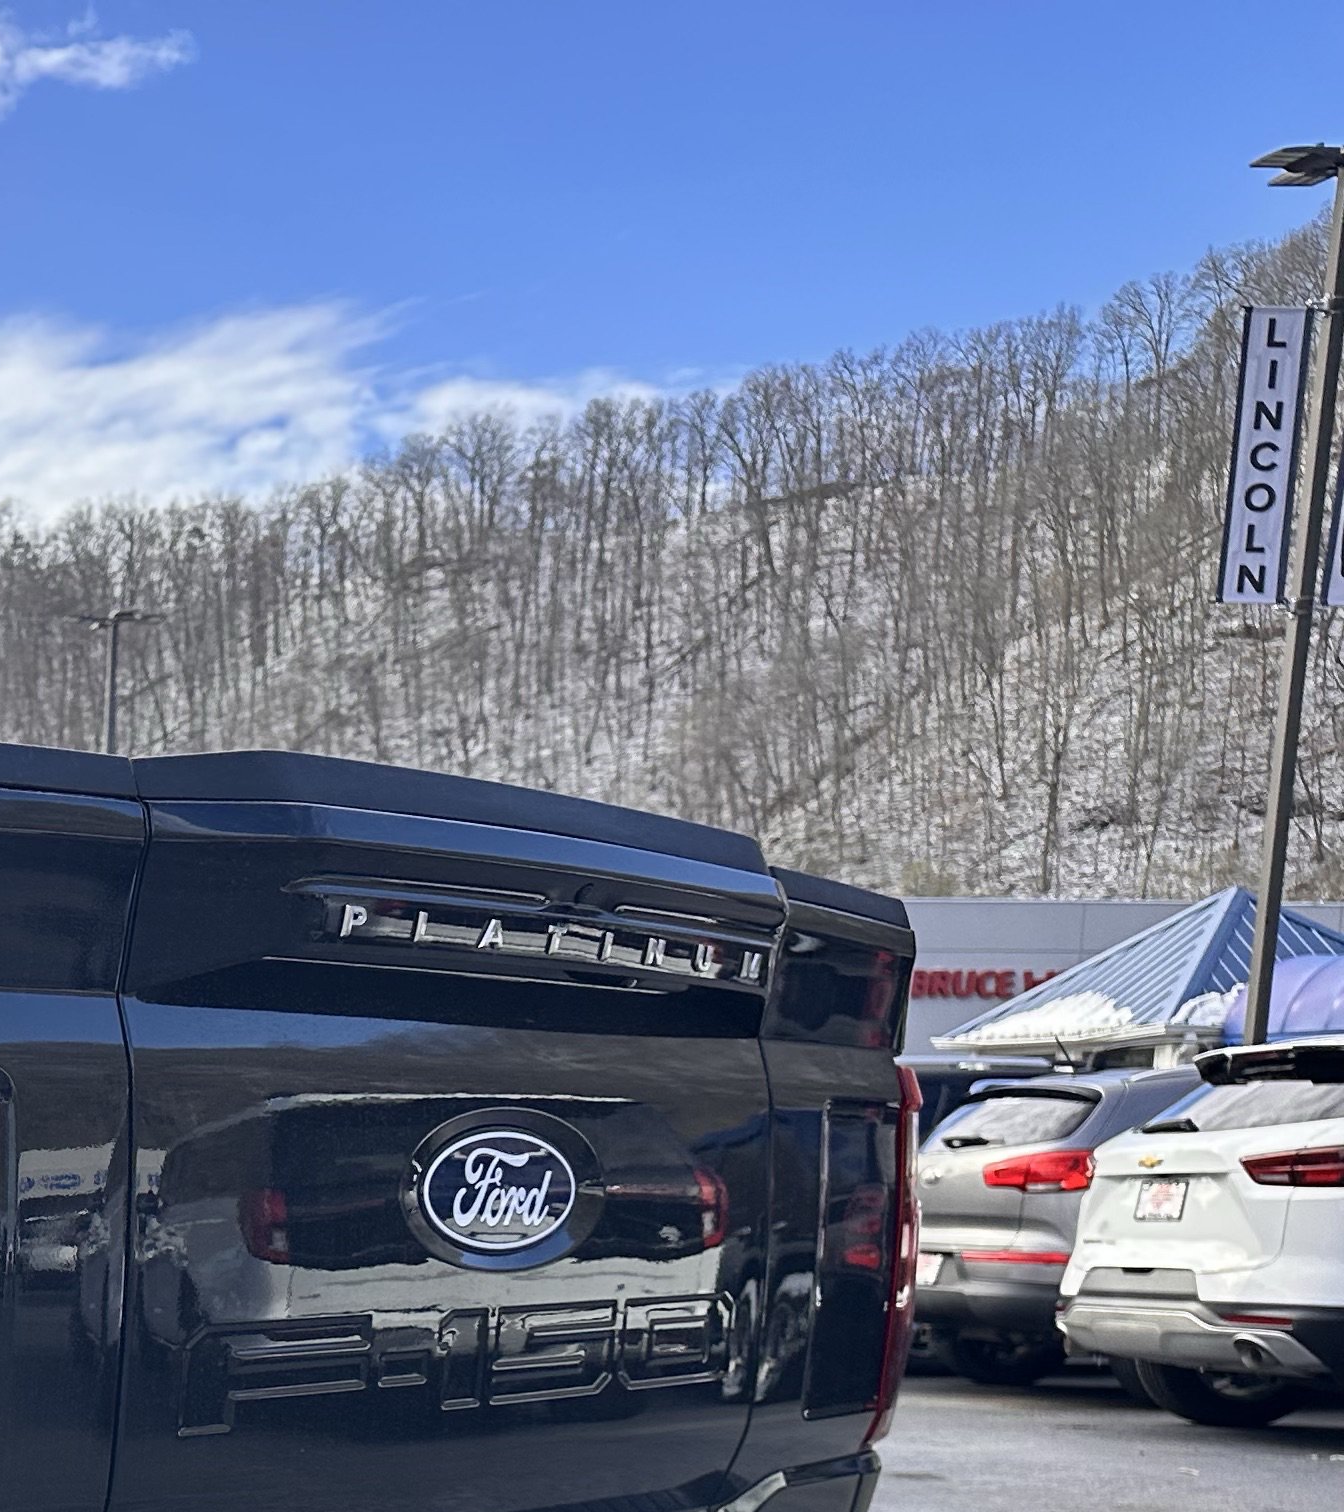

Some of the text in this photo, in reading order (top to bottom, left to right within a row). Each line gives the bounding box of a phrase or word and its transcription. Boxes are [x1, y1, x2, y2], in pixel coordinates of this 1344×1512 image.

[1236, 317, 1287, 594] LINCOLN
[340, 903, 762, 982] PLATINUM
[911, 970, 1016, 998] BRUCE
[452, 1147, 553, 1227] Ford
[178, 1290, 737, 1437] F-150
